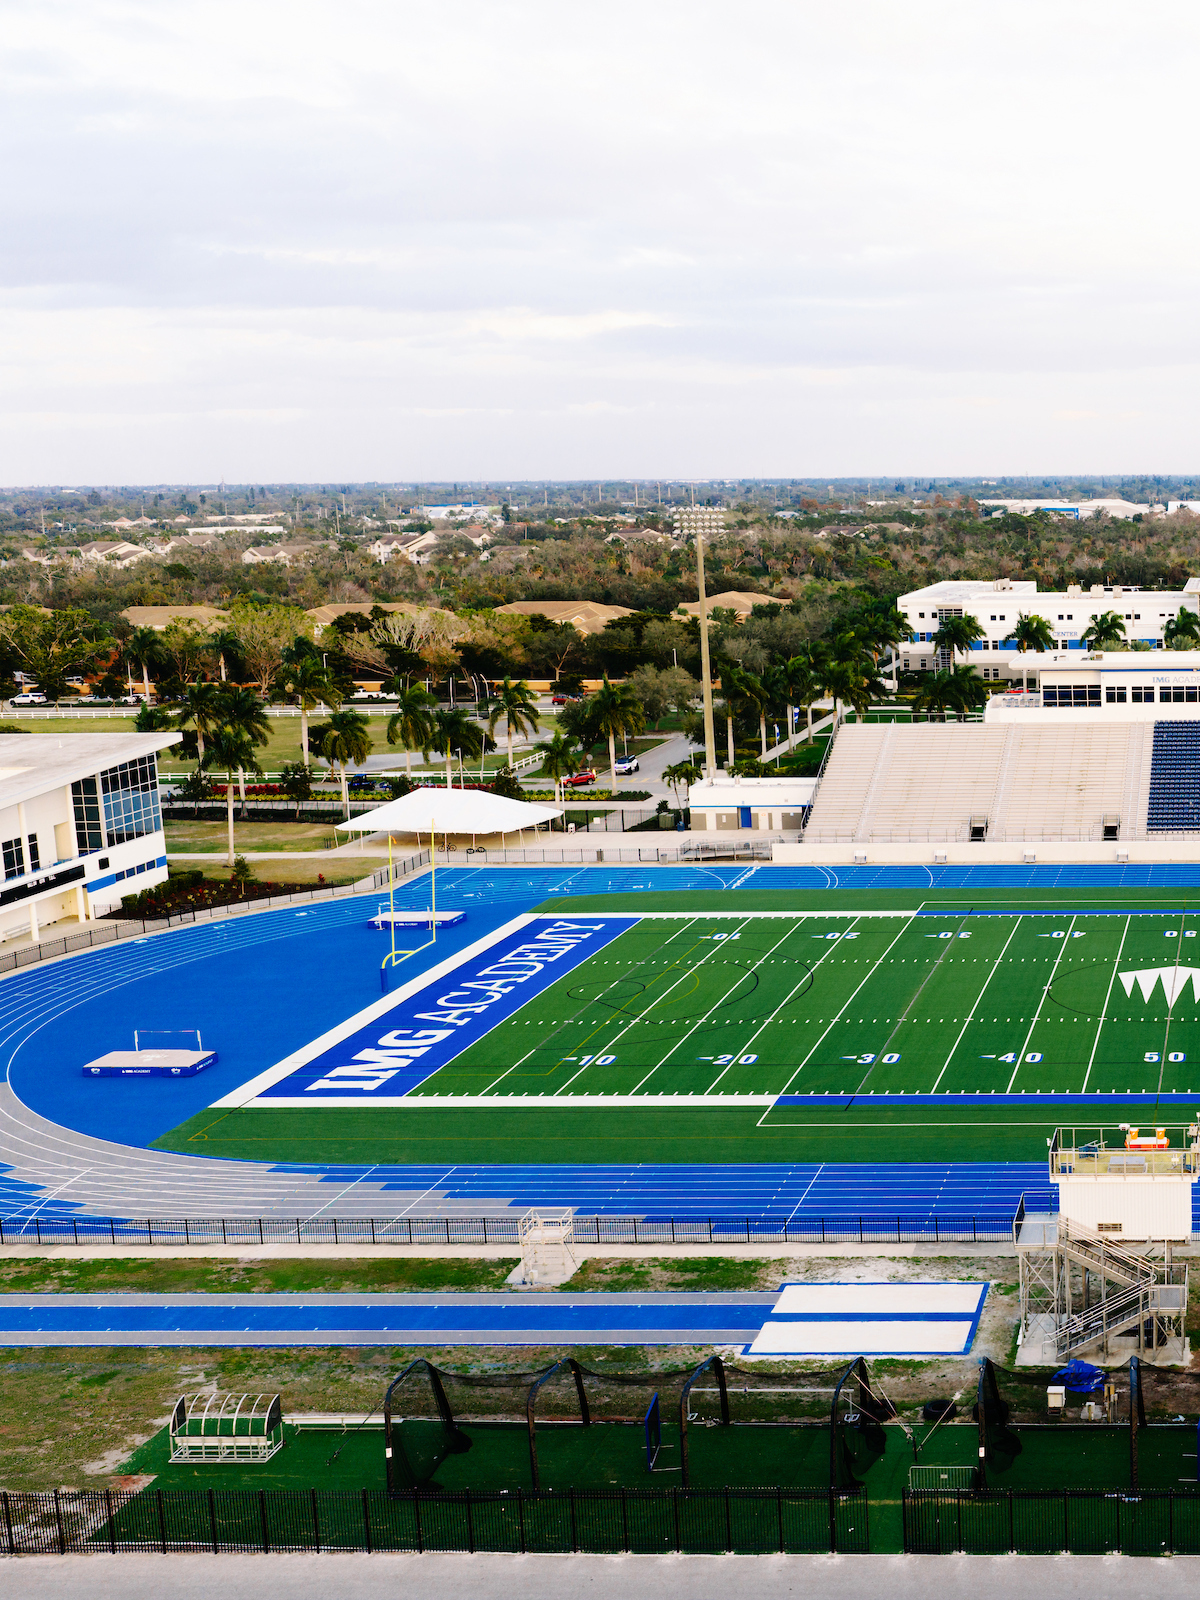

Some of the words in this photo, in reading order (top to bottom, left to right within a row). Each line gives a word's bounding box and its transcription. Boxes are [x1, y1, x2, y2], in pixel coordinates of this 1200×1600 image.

[304, 1029, 456, 1091] IMG
[413, 921, 605, 1026] ACADEMY
[578, 1054, 618, 1066] 10
[712, 1054, 759, 1066] 20
[856, 1053, 902, 1065] 30
[998, 1052, 1044, 1064] 40
[1143, 1052, 1187, 1063] 50
